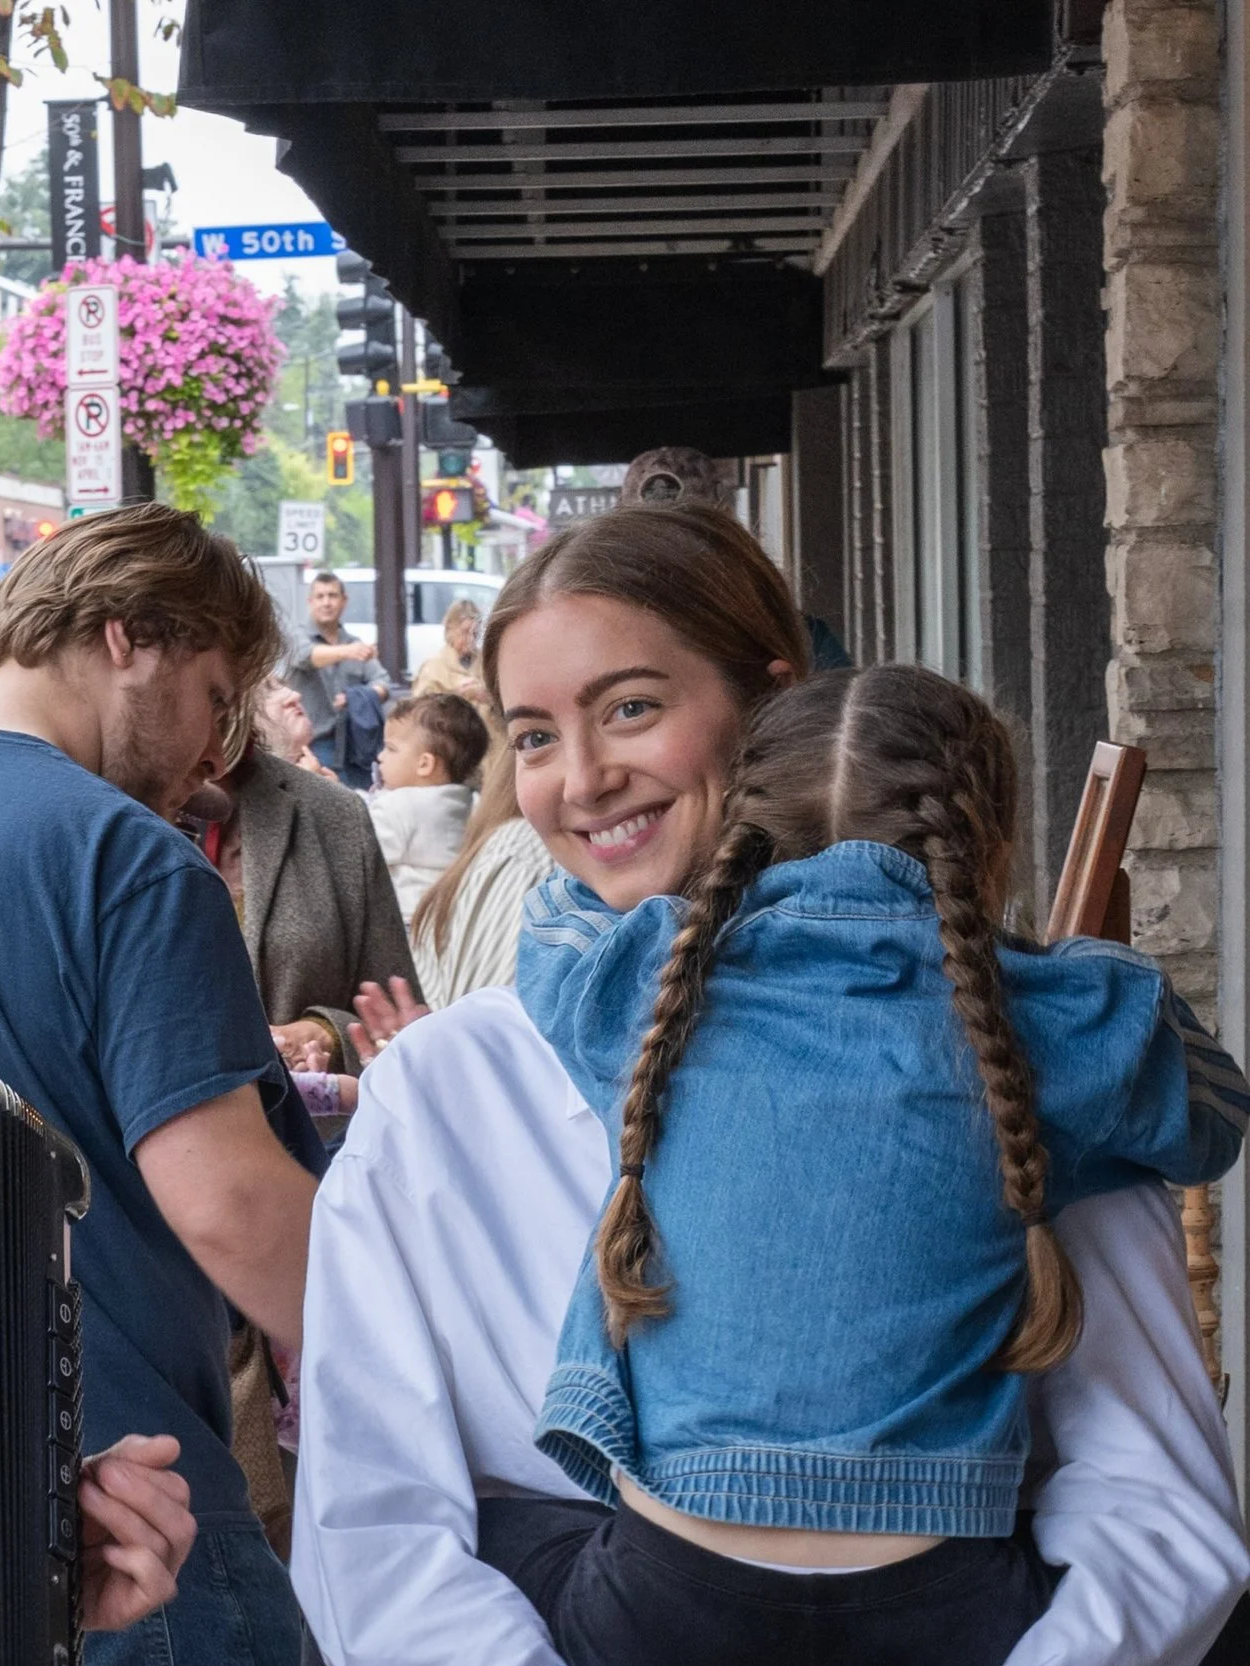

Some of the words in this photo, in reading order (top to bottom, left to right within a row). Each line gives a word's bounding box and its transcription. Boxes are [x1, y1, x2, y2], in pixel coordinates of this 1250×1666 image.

[63, 149, 84, 172] &
[201, 233, 226, 260] W
[241, 229, 315, 255] 50th
[80, 350, 105, 363] STOP
[285, 508, 321, 518] SPEED
[287, 520, 316, 529] LIMIT
[284, 531, 319, 553] 30
